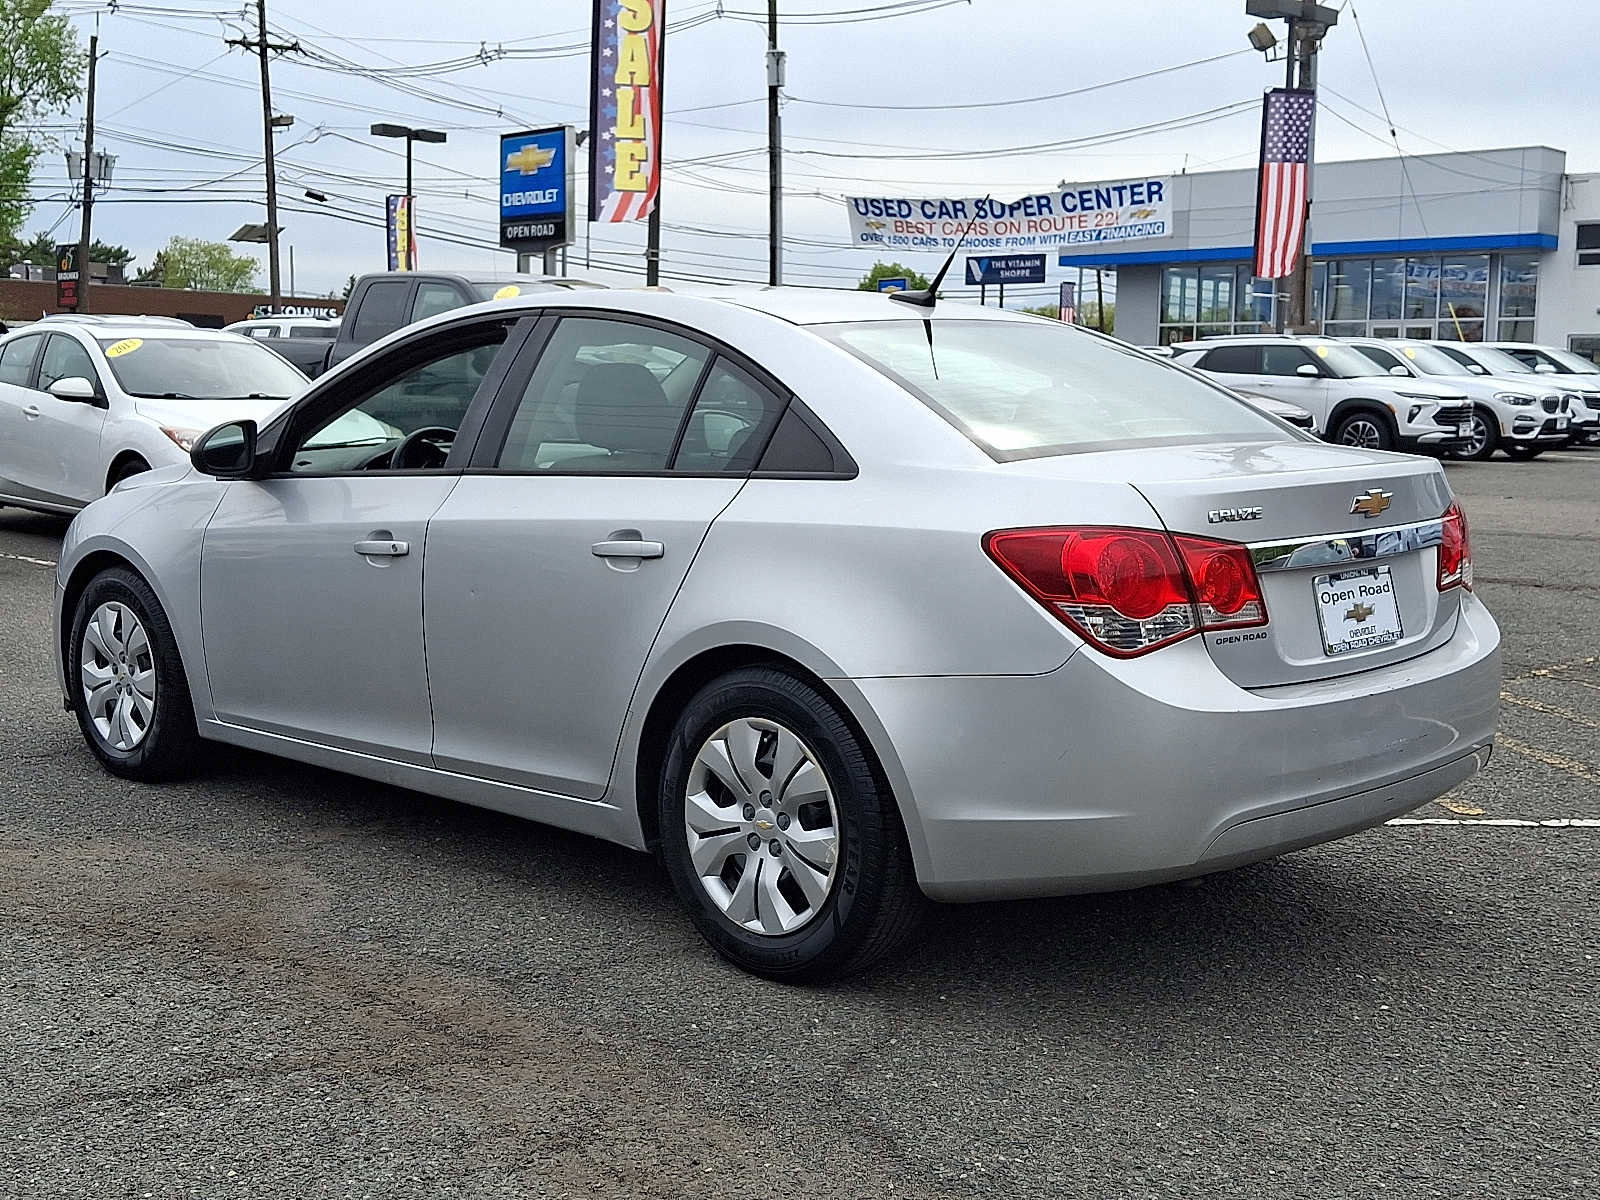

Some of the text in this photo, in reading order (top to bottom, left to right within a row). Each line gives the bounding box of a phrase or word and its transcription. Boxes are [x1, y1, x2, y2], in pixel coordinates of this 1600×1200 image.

[614, 0, 653, 192] SALE
[503, 188, 559, 206] CHEVROLET
[854, 181, 1164, 220] USED CAR SUPER CENTER
[507, 224, 555, 238] OPEN ROAD
[894, 212, 1120, 236] BEST CARS ON ROUTE 22!
[860, 223, 1164, 248] OVER 1500 CARS TO CHOOSE FROM WITH EASY FINANCING
[1007, 259, 1040, 267] VITAMIN
[1000, 269, 1030, 278] SHOPPE
[1208, 506, 1263, 523] CRUZE
[1321, 581, 1390, 605] Open Road
[1216, 632, 1267, 645] OPEN ROAD
[1349, 625, 1377, 638] CHEVROLET
[1333, 632, 1401, 653] OPEN ROAD CHEVROLET
